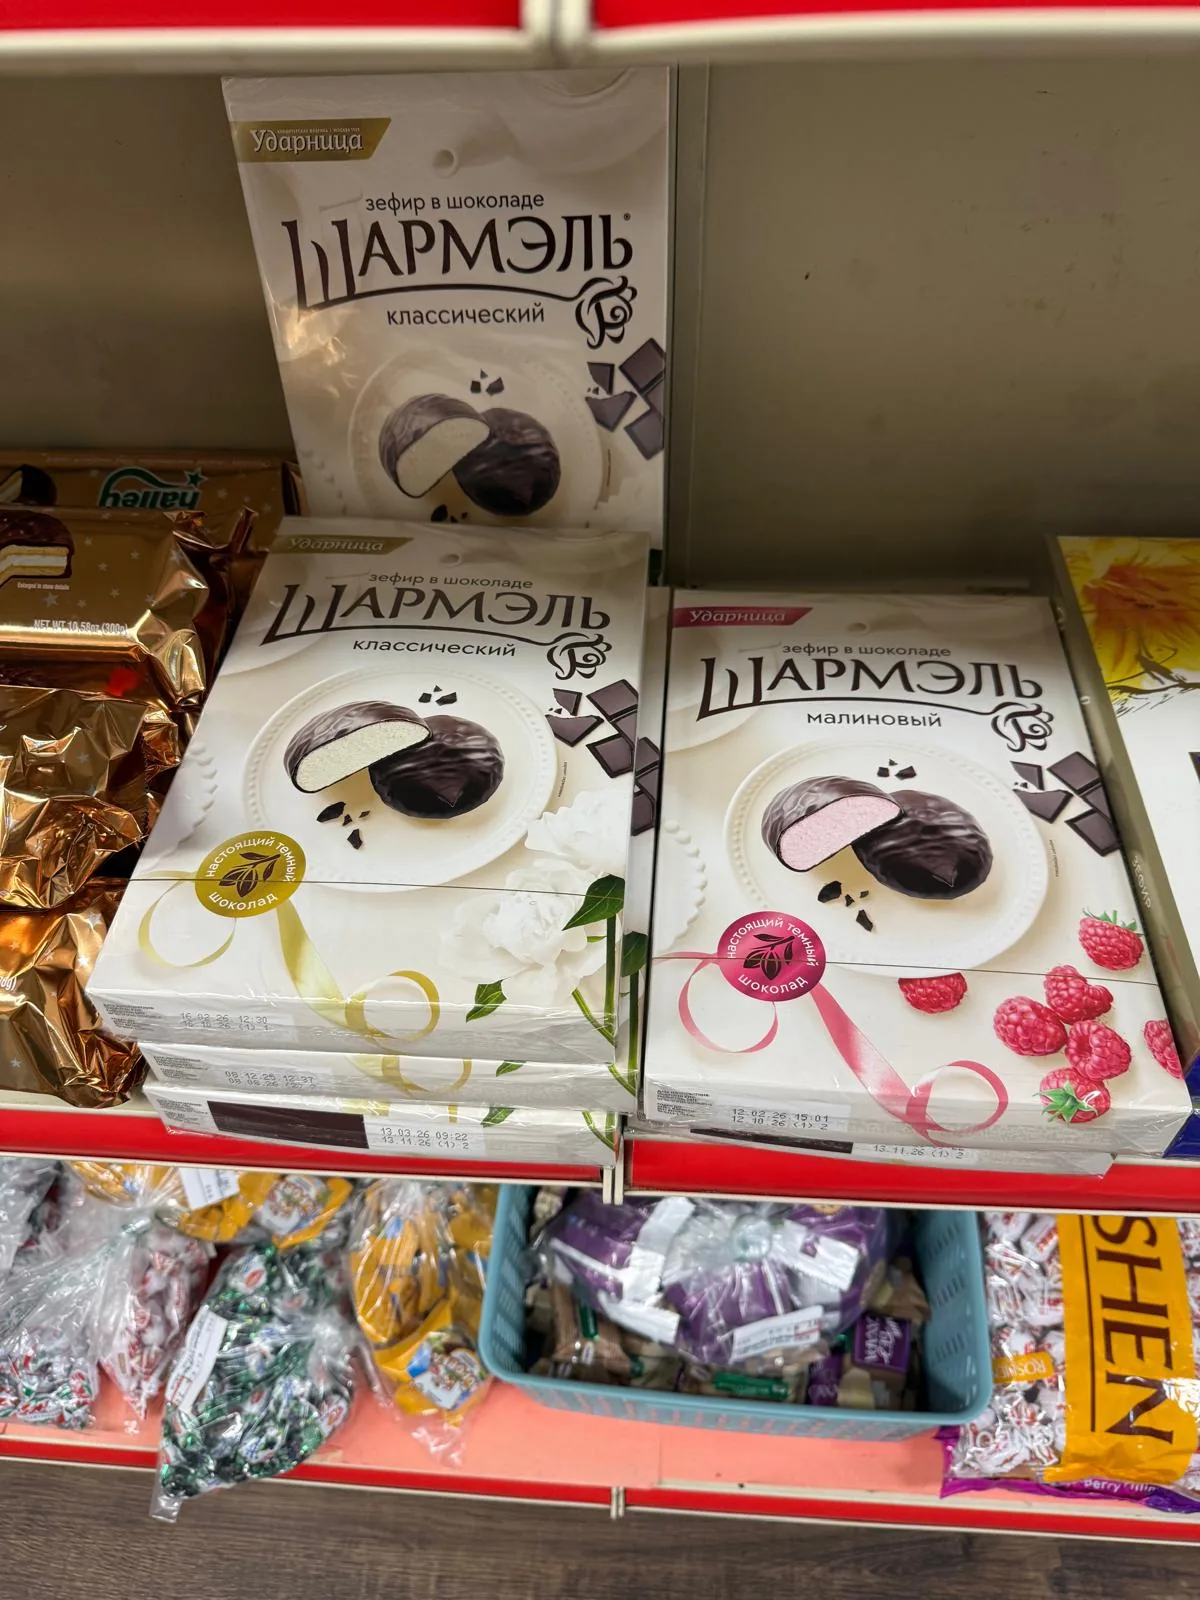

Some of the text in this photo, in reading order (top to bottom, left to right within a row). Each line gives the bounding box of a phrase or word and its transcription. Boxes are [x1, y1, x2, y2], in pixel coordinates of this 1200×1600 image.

[250, 129, 365, 155] Ударница
[366, 192, 545, 216] зефир в шоколаде
[281, 213, 635, 310] ШАРМЭЛЬ
[387, 303, 545, 326] классический
[97, 467, 203, 510] halley
[290, 537, 385, 552] Ударница
[369, 572, 533, 590] зефир в шоколаде
[260, 583, 612, 646] ШАРМЭЛЬ
[689, 610, 786, 623] Ударница
[34, 619, 51, 630] NET
[52, 620, 67, 632] WT
[352, 639, 517, 657] классический
[782, 643, 952, 658] зефир в шоколаде
[696, 655, 1043, 723] ШАРМЭЛЬ
[807, 712, 942, 728] малиновый
[206, 836, 297, 883] настоящий темный
[208, 891, 278, 911] шоколад
[727, 917, 820, 967] настоящий темный
[737, 974, 809, 994] шоколад
[382, 1135, 470, 1150] 13.11.26 (1) 2
[435, 1131, 468, 1142] 09:22
[873, 1144, 964, 1159] 13.11.26 (1) 2
